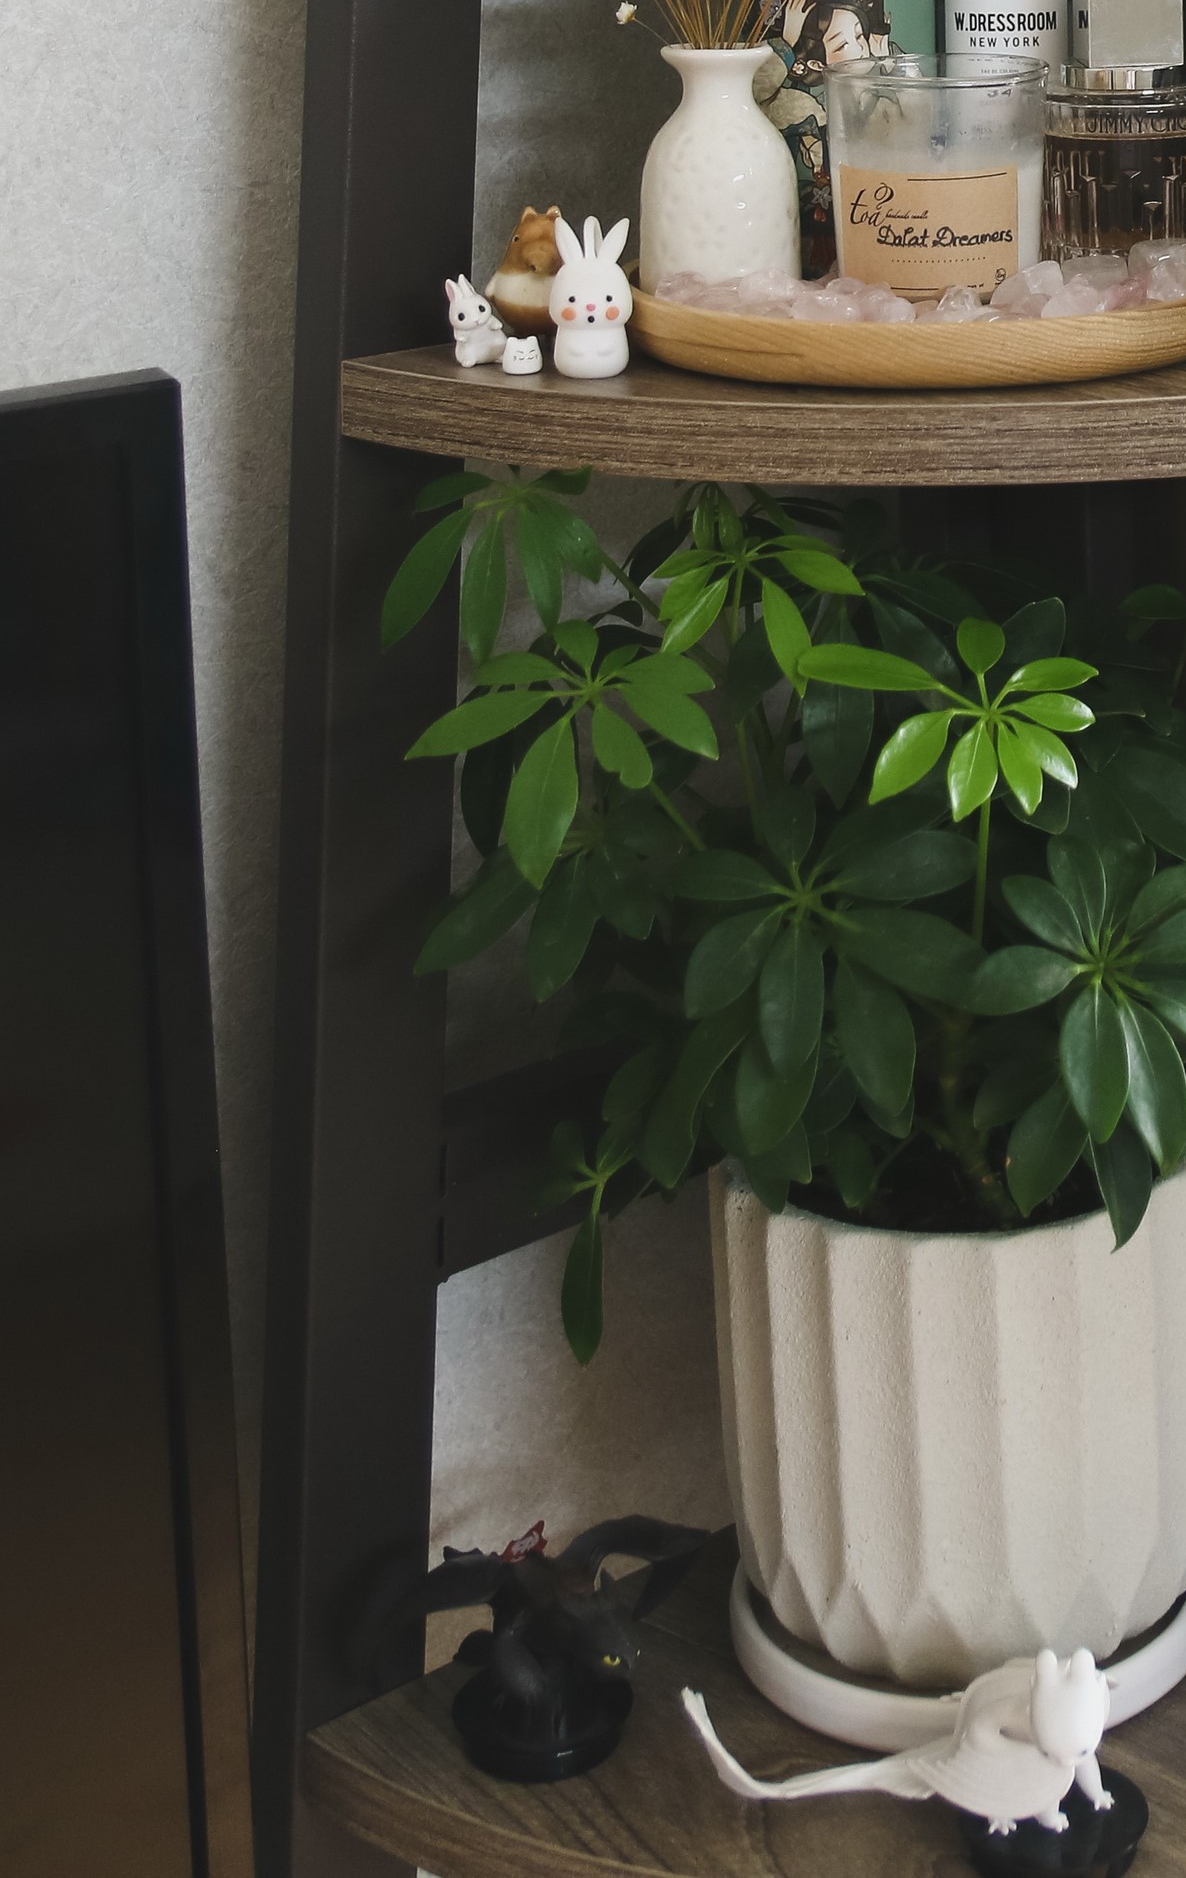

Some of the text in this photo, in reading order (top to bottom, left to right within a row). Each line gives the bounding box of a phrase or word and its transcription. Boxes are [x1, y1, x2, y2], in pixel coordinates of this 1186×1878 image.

[954, 10, 1057, 32] W.DRESSROOM
[970, 36, 1041, 48] NEW YORK
[1087, 113, 1144, 134] JIMMY
[931, 226, 1013, 248] Dreamers
